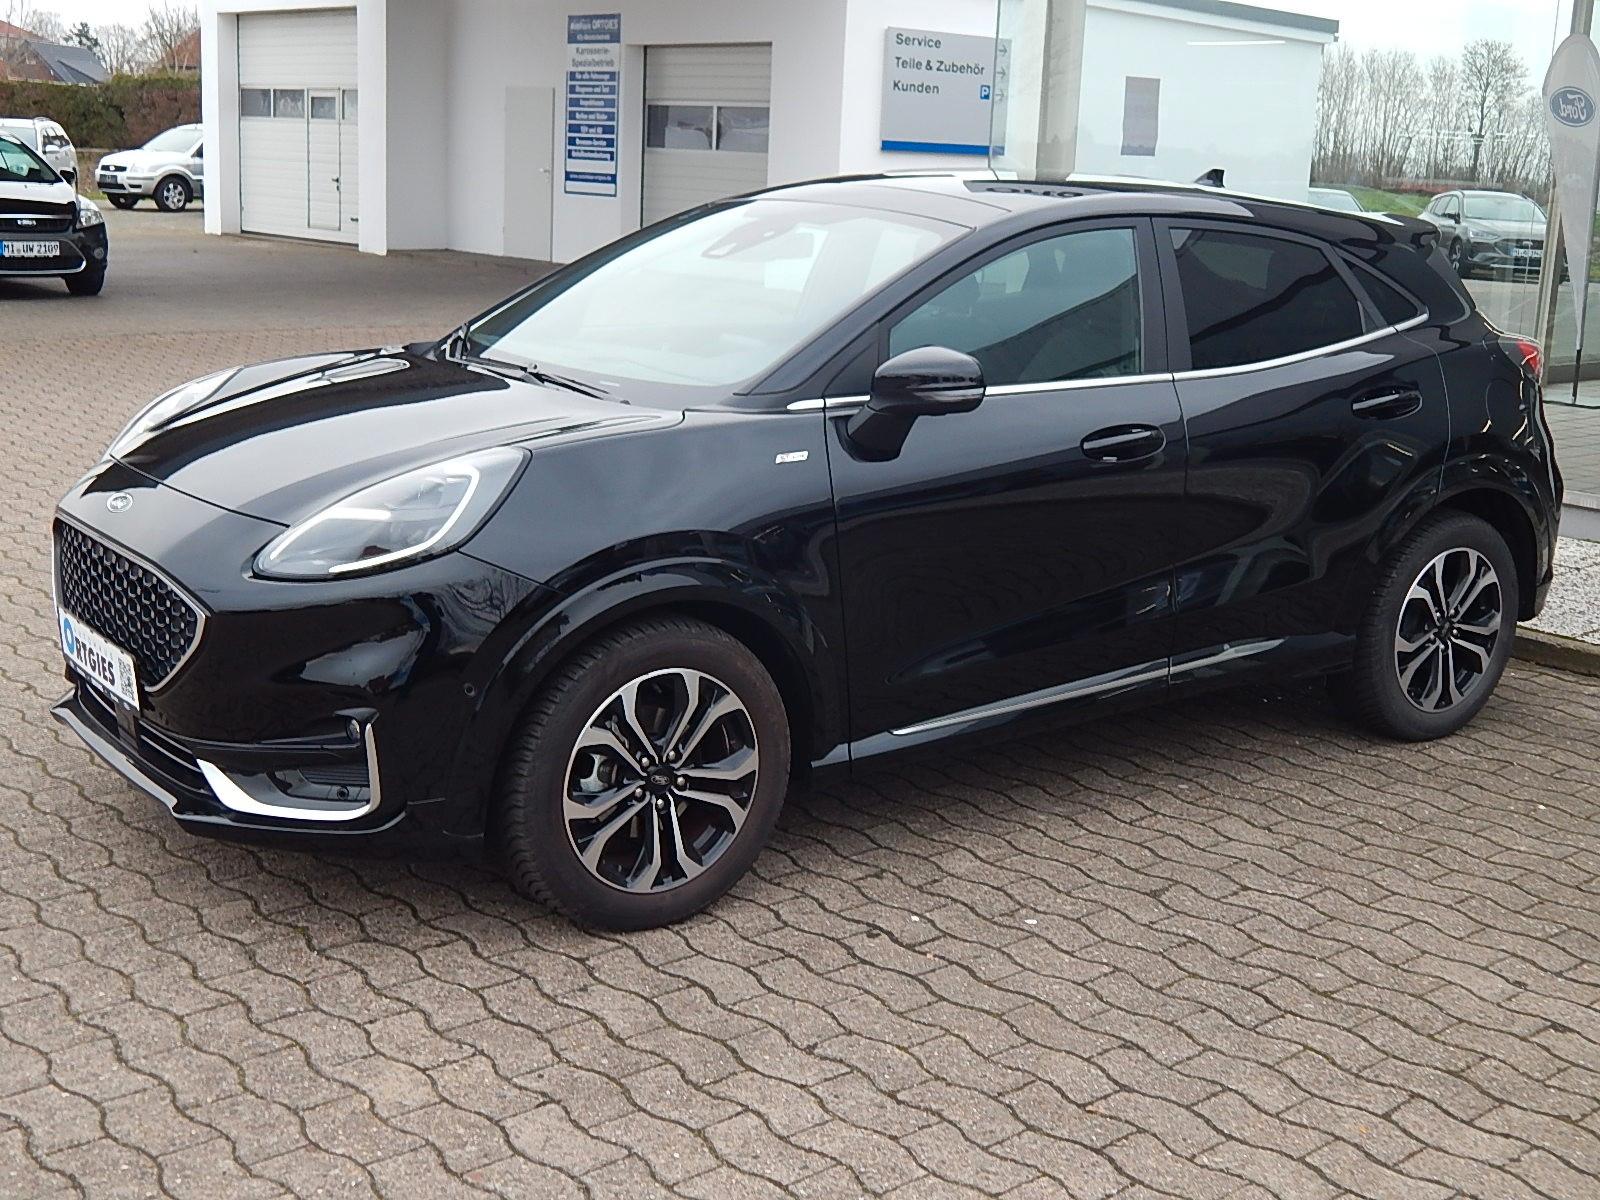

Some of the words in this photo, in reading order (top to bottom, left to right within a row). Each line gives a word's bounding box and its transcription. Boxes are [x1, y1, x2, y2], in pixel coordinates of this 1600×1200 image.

[896, 33, 942, 49] Service
[895, 56, 922, 70] Teile
[925, 59, 933, 71] &
[936, 60, 985, 76] Zubehör
[893, 80, 940, 95] Kunden
